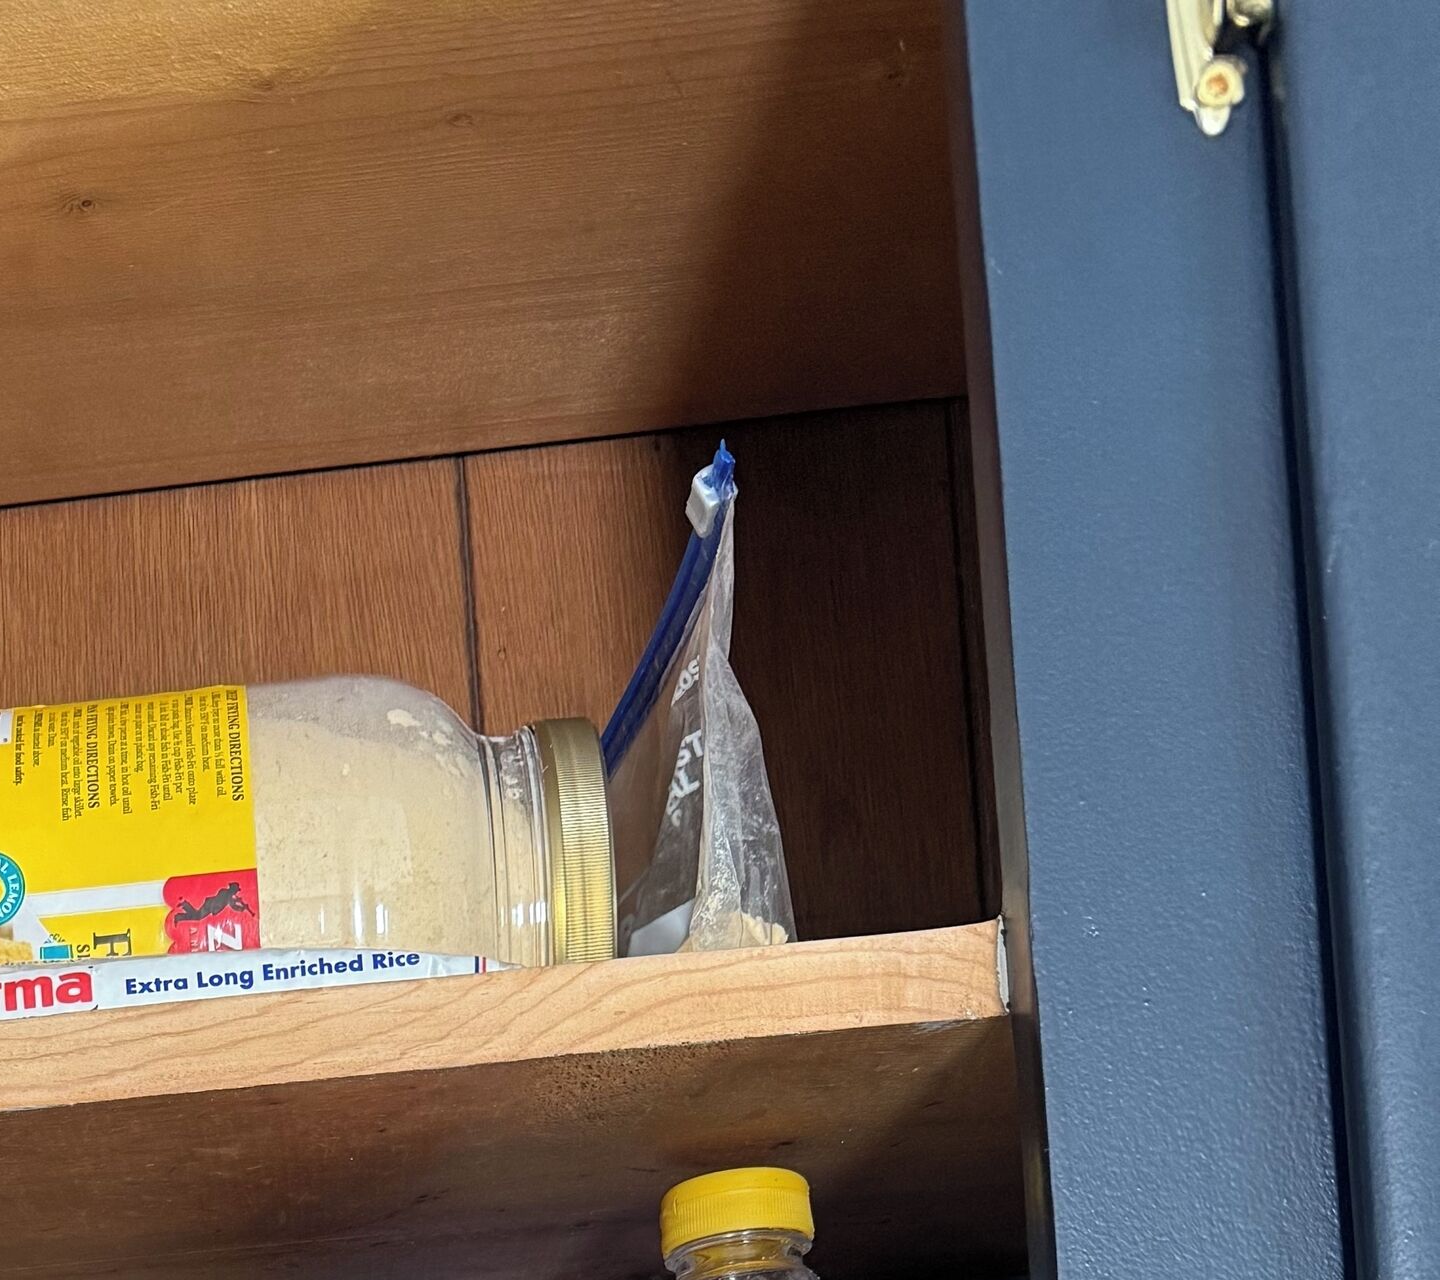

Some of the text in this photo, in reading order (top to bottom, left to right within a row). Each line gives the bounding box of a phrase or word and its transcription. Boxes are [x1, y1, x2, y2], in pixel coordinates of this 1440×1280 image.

[126, 950, 420, 995] Extra Long Enriched Rice
